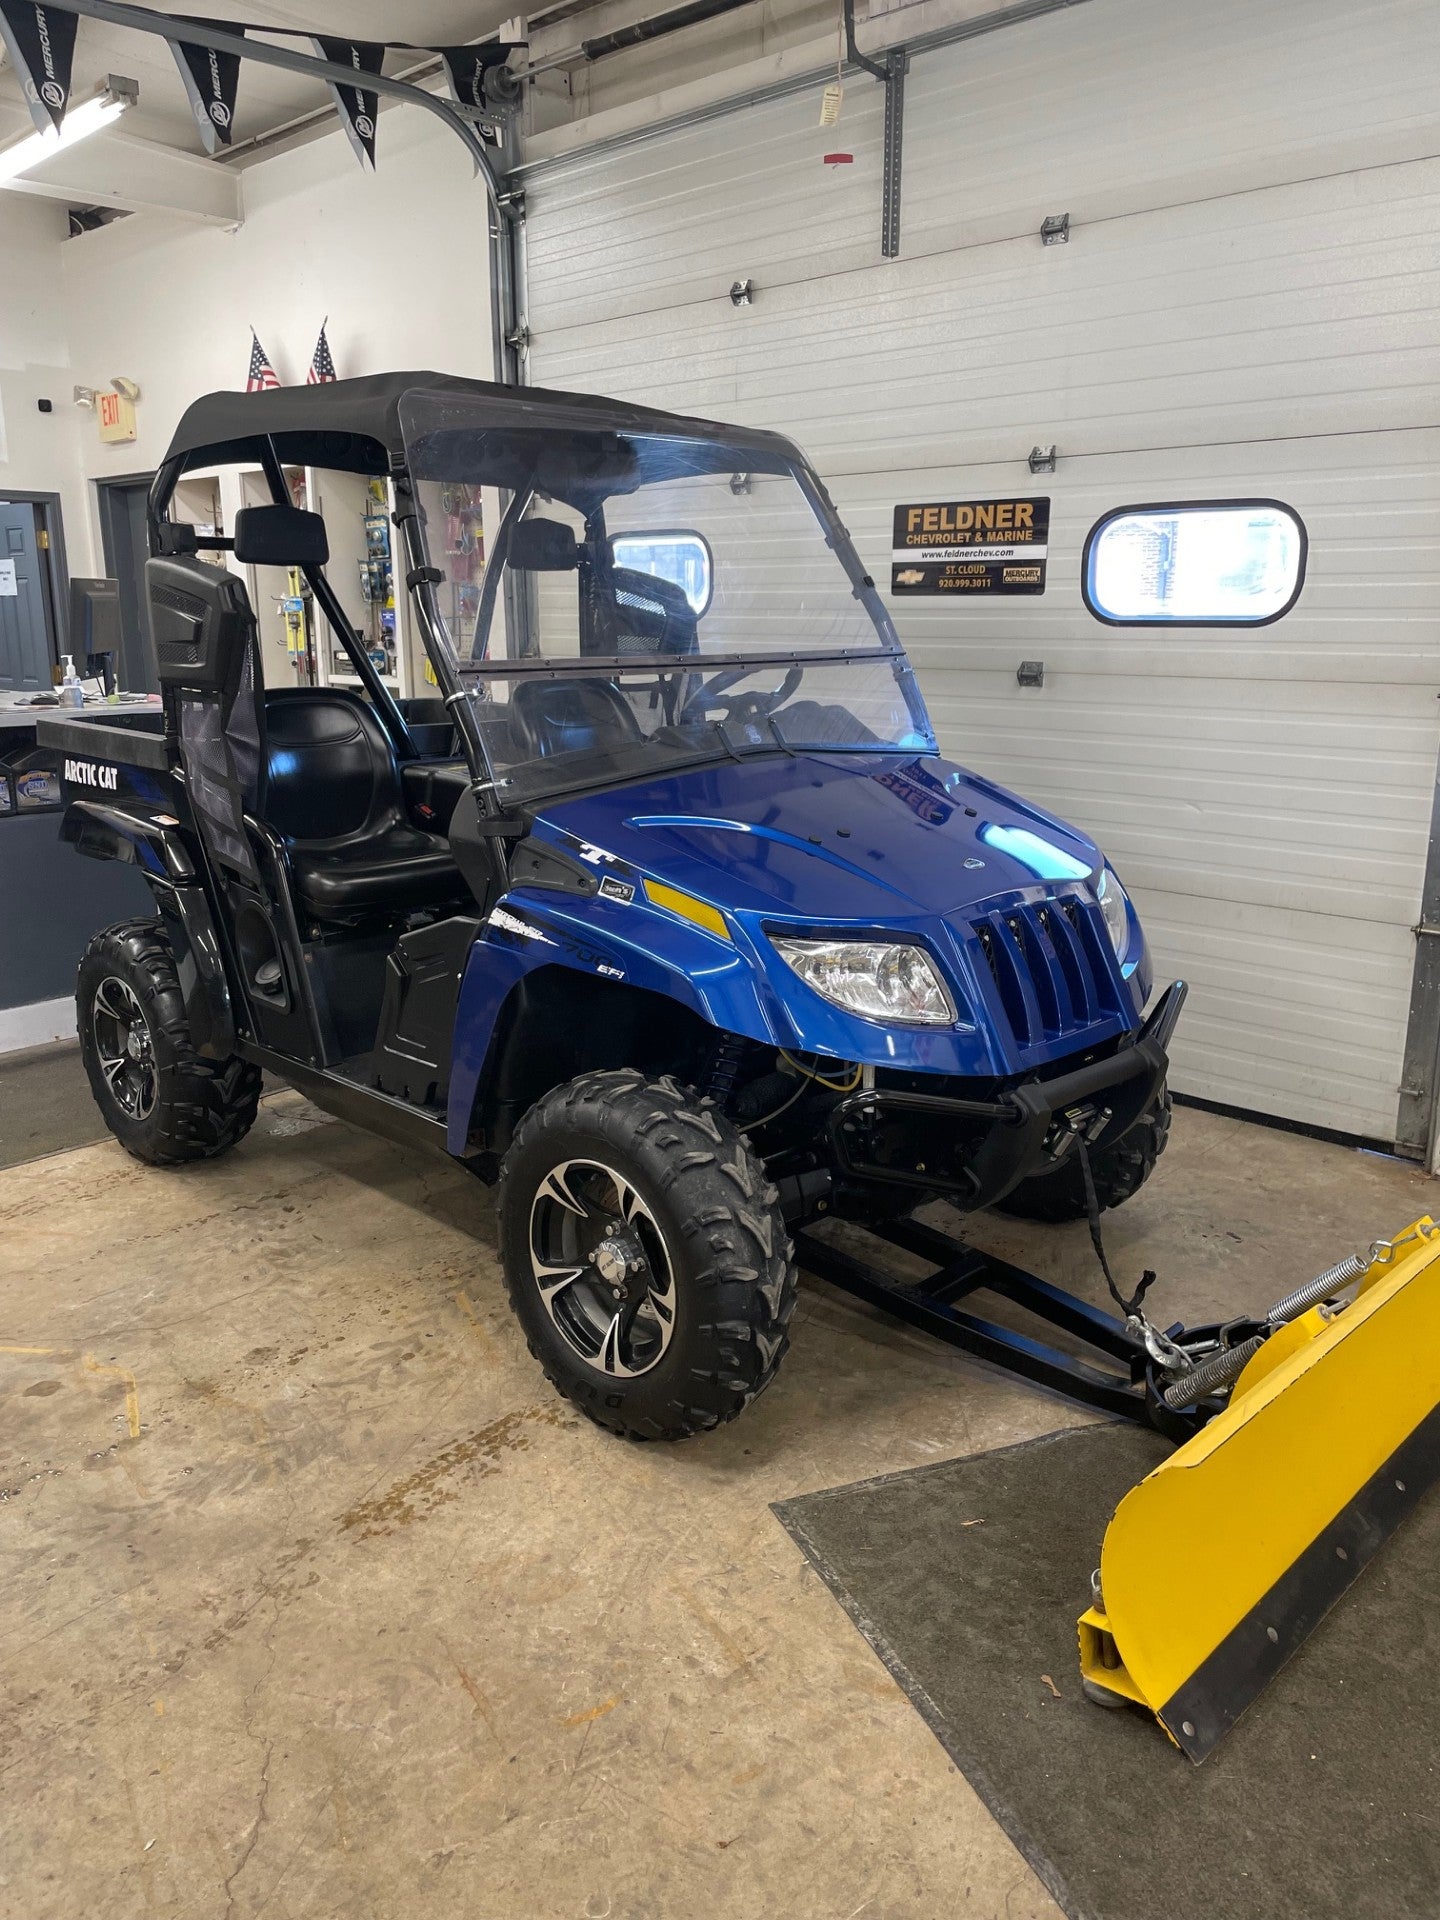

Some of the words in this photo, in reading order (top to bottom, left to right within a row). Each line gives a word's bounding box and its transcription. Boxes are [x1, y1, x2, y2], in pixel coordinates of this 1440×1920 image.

[35, 3, 55, 79] MERCURY
[208, 48, 222, 100] MERCU
[101, 393, 120, 427] EXIT
[907, 503, 1034, 532] FELDNER
[906, 532, 972, 545] CHEVROLET
[974, 532, 983, 543] &
[986, 530, 1034, 542] MARINE
[921, 549, 1015, 559] www.feldnerchev.com
[945, 566, 958, 575] ST.
[957, 564, 986, 575] CLOUD
[1005, 570, 1040, 578] MERCURY
[938, 578, 992, 588] 920.999.3011
[65, 759, 97, 787] ARCTIC
[98, 765, 118, 790] CAT
[596, 964, 626, 979] EFI
